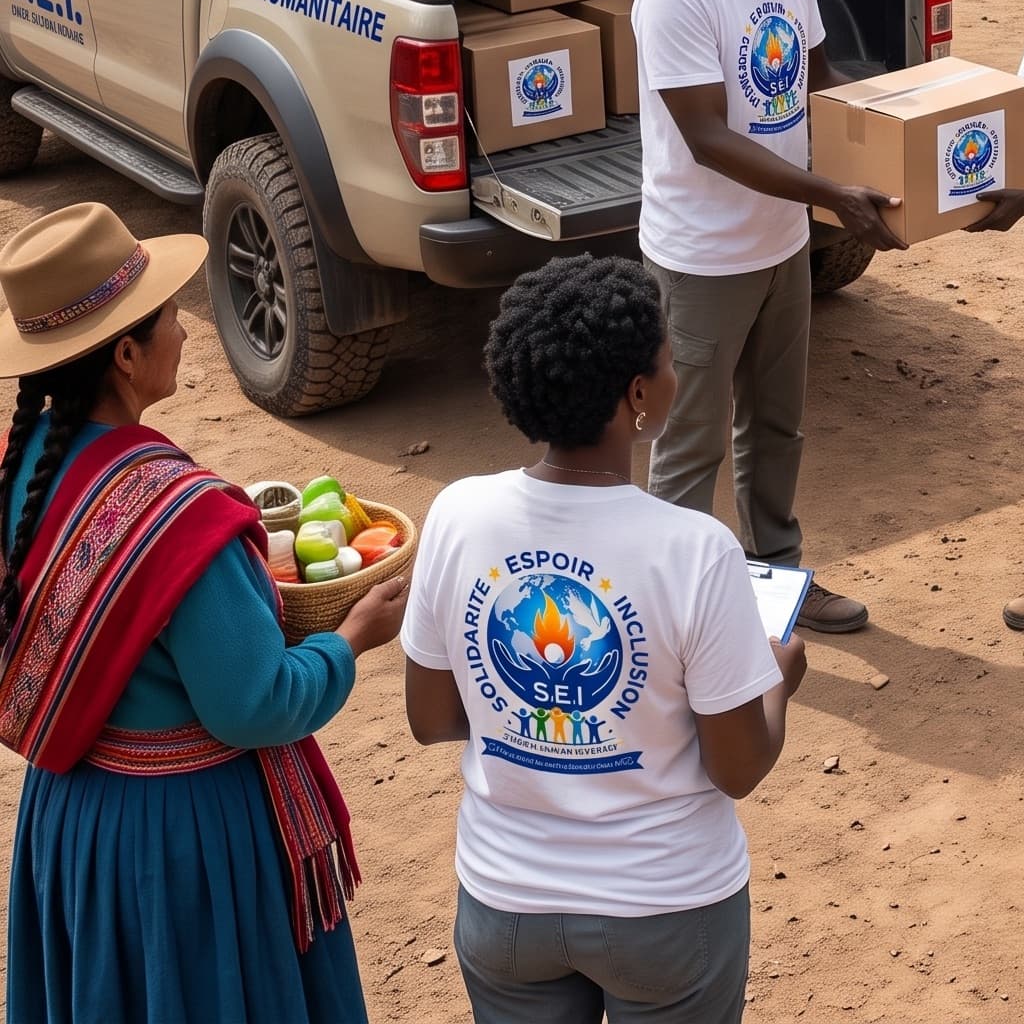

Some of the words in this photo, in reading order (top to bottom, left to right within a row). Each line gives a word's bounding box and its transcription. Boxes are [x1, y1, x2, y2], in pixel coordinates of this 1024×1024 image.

[505, 550, 595, 581] ESPOIR
[464, 578, 508, 713] SOLIDARITE
[610, 595, 649, 720] INCLUSION
